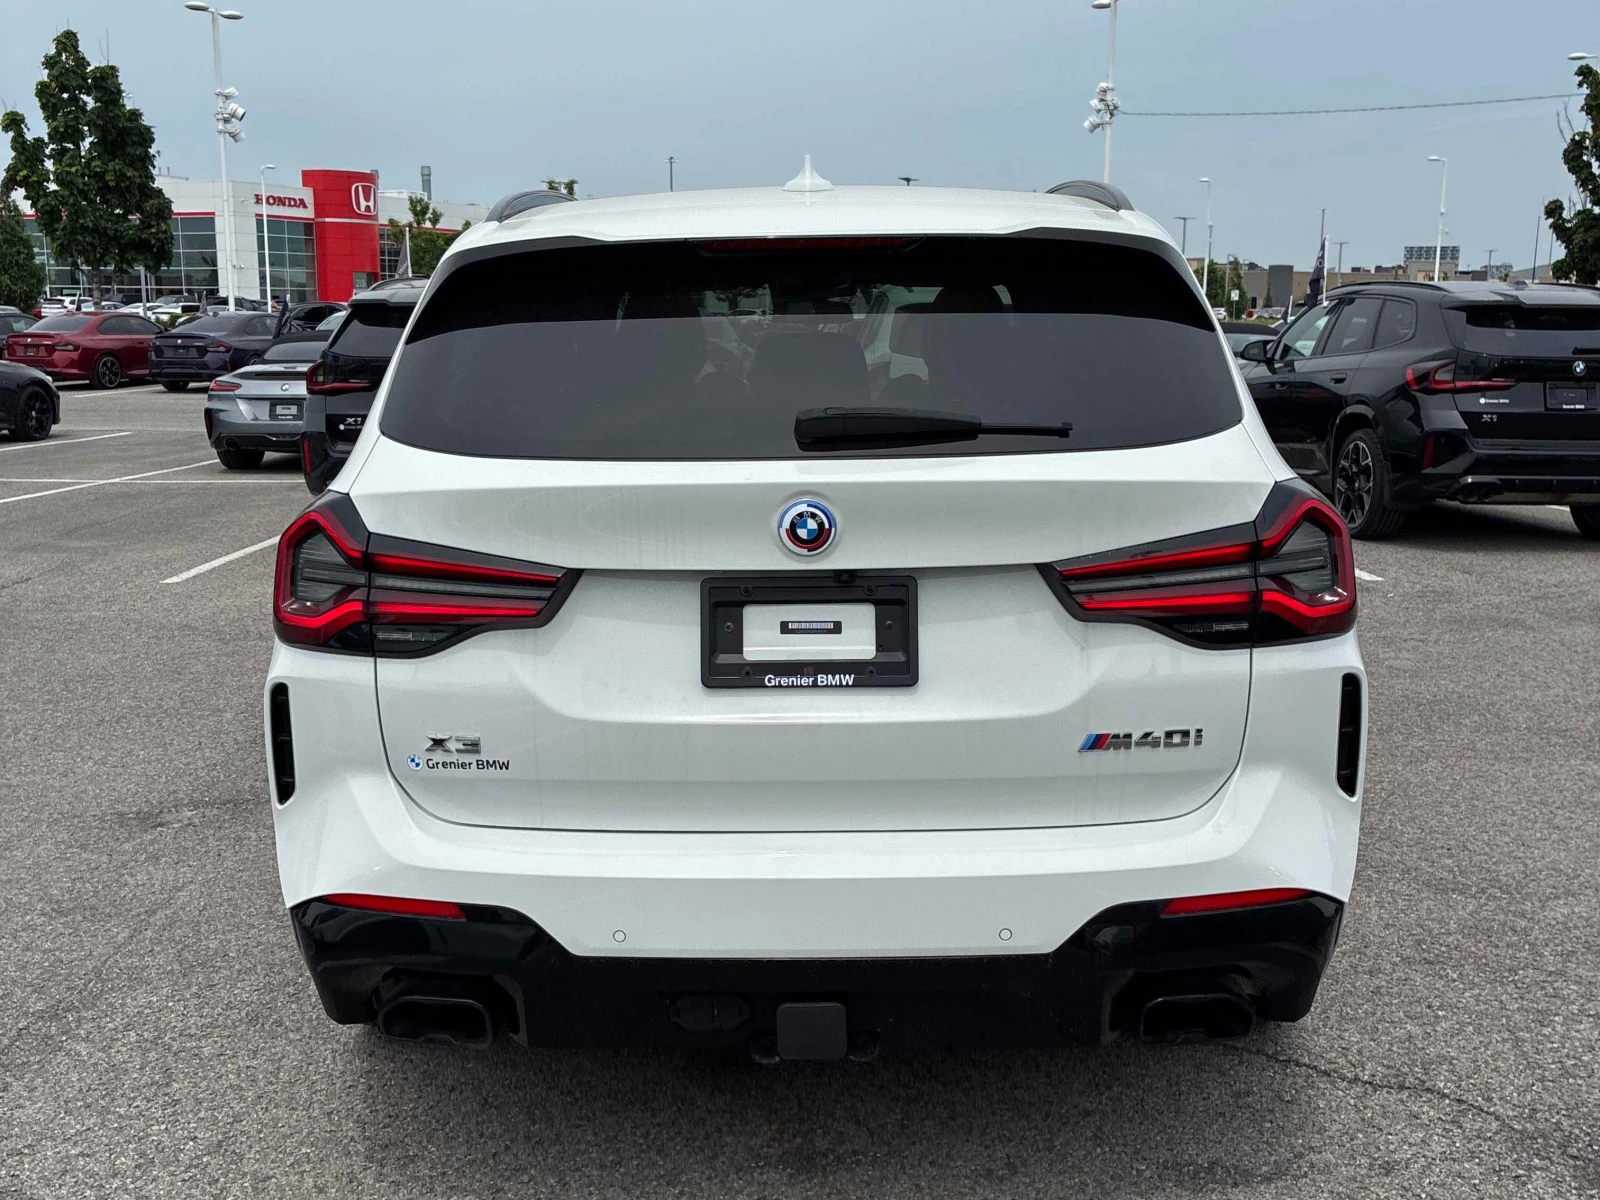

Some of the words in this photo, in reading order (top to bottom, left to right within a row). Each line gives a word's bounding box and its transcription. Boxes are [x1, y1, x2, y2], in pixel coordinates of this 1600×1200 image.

[254, 193, 308, 209] HONDA
[344, 417, 362, 425] X1
[793, 511, 823, 524] BMW
[764, 674, 814, 686] Grenier
[817, 673, 855, 686] BMW
[425, 733, 481, 754] X3
[1100, 728, 1204, 751] M40i
[426, 758, 473, 770] Grenier
[476, 759, 510, 771] BMW
